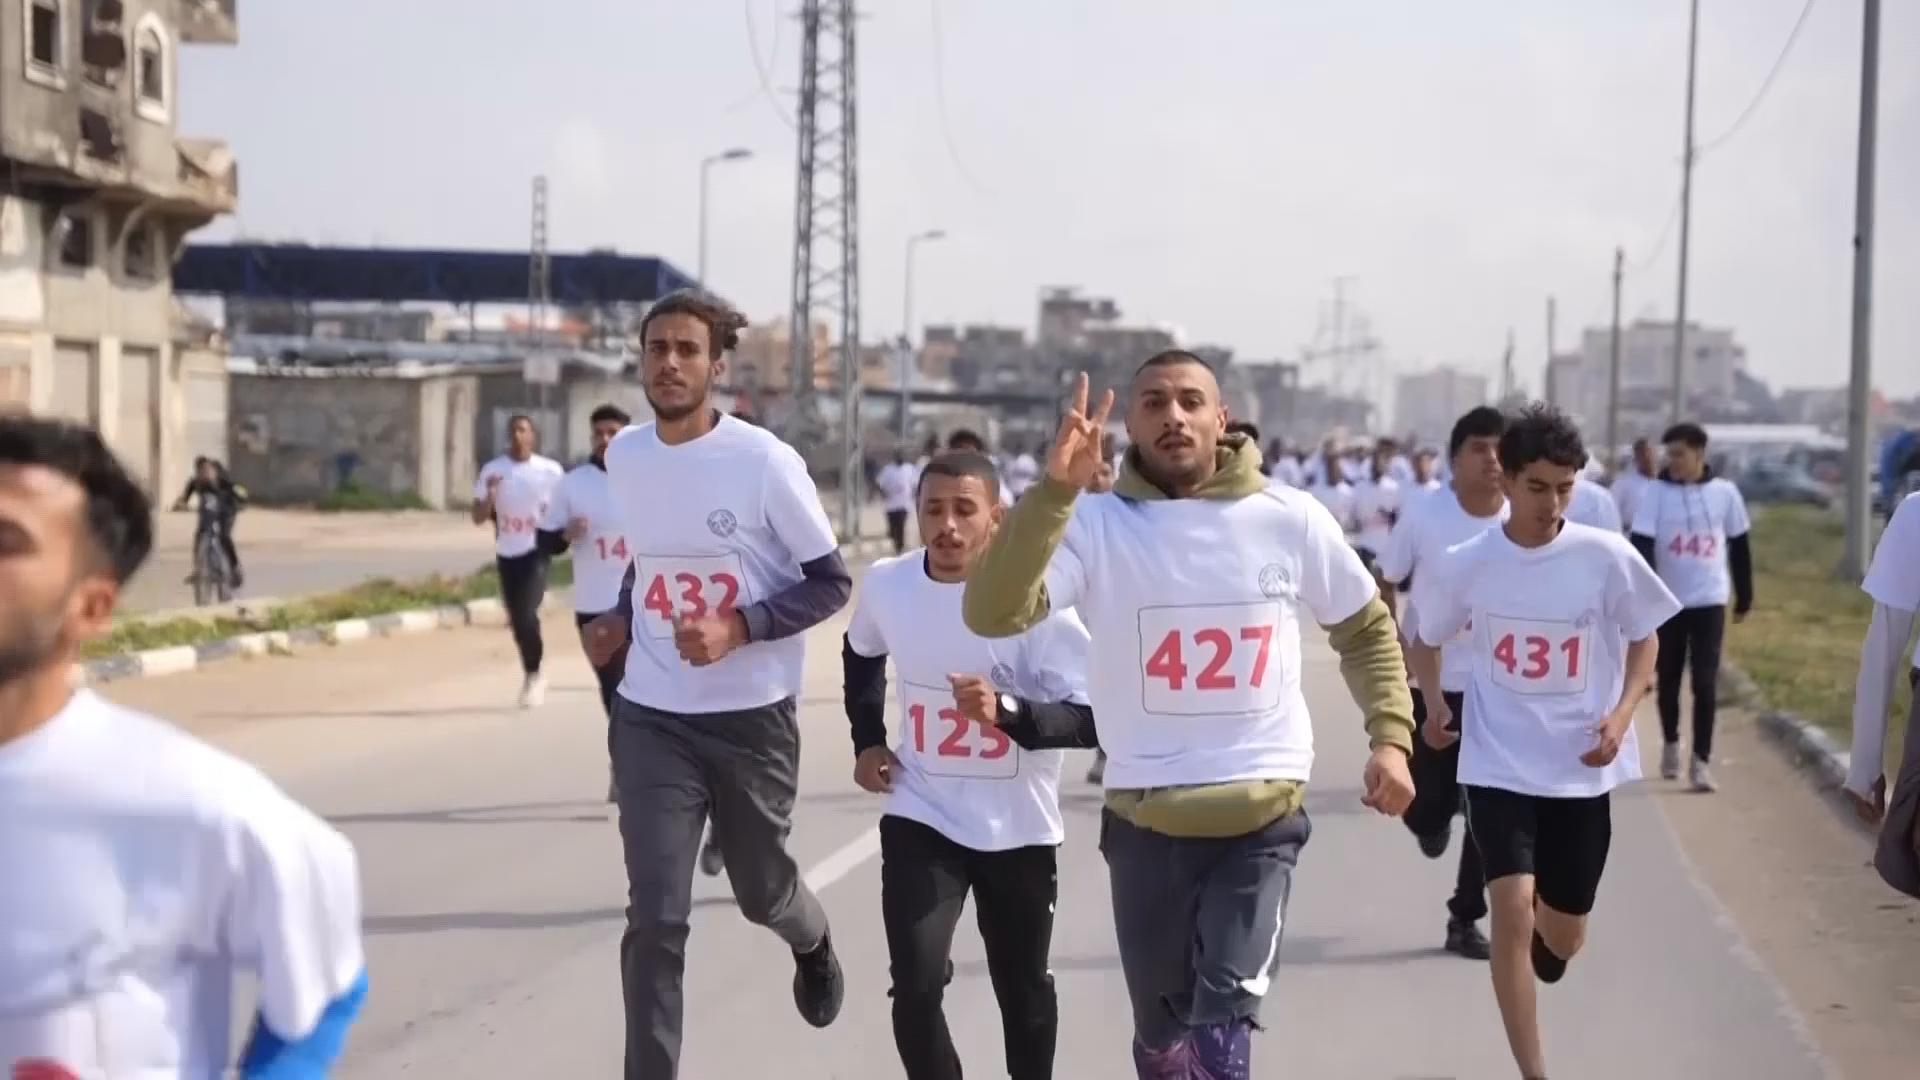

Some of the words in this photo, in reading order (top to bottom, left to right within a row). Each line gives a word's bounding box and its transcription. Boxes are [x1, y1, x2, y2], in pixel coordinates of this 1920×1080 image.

[1668, 534, 1717, 558] 442
[644, 572, 740, 621] 432
[1146, 626, 1273, 691] 427
[1494, 633, 1580, 679] 431
[908, 704, 1010, 759] 125
